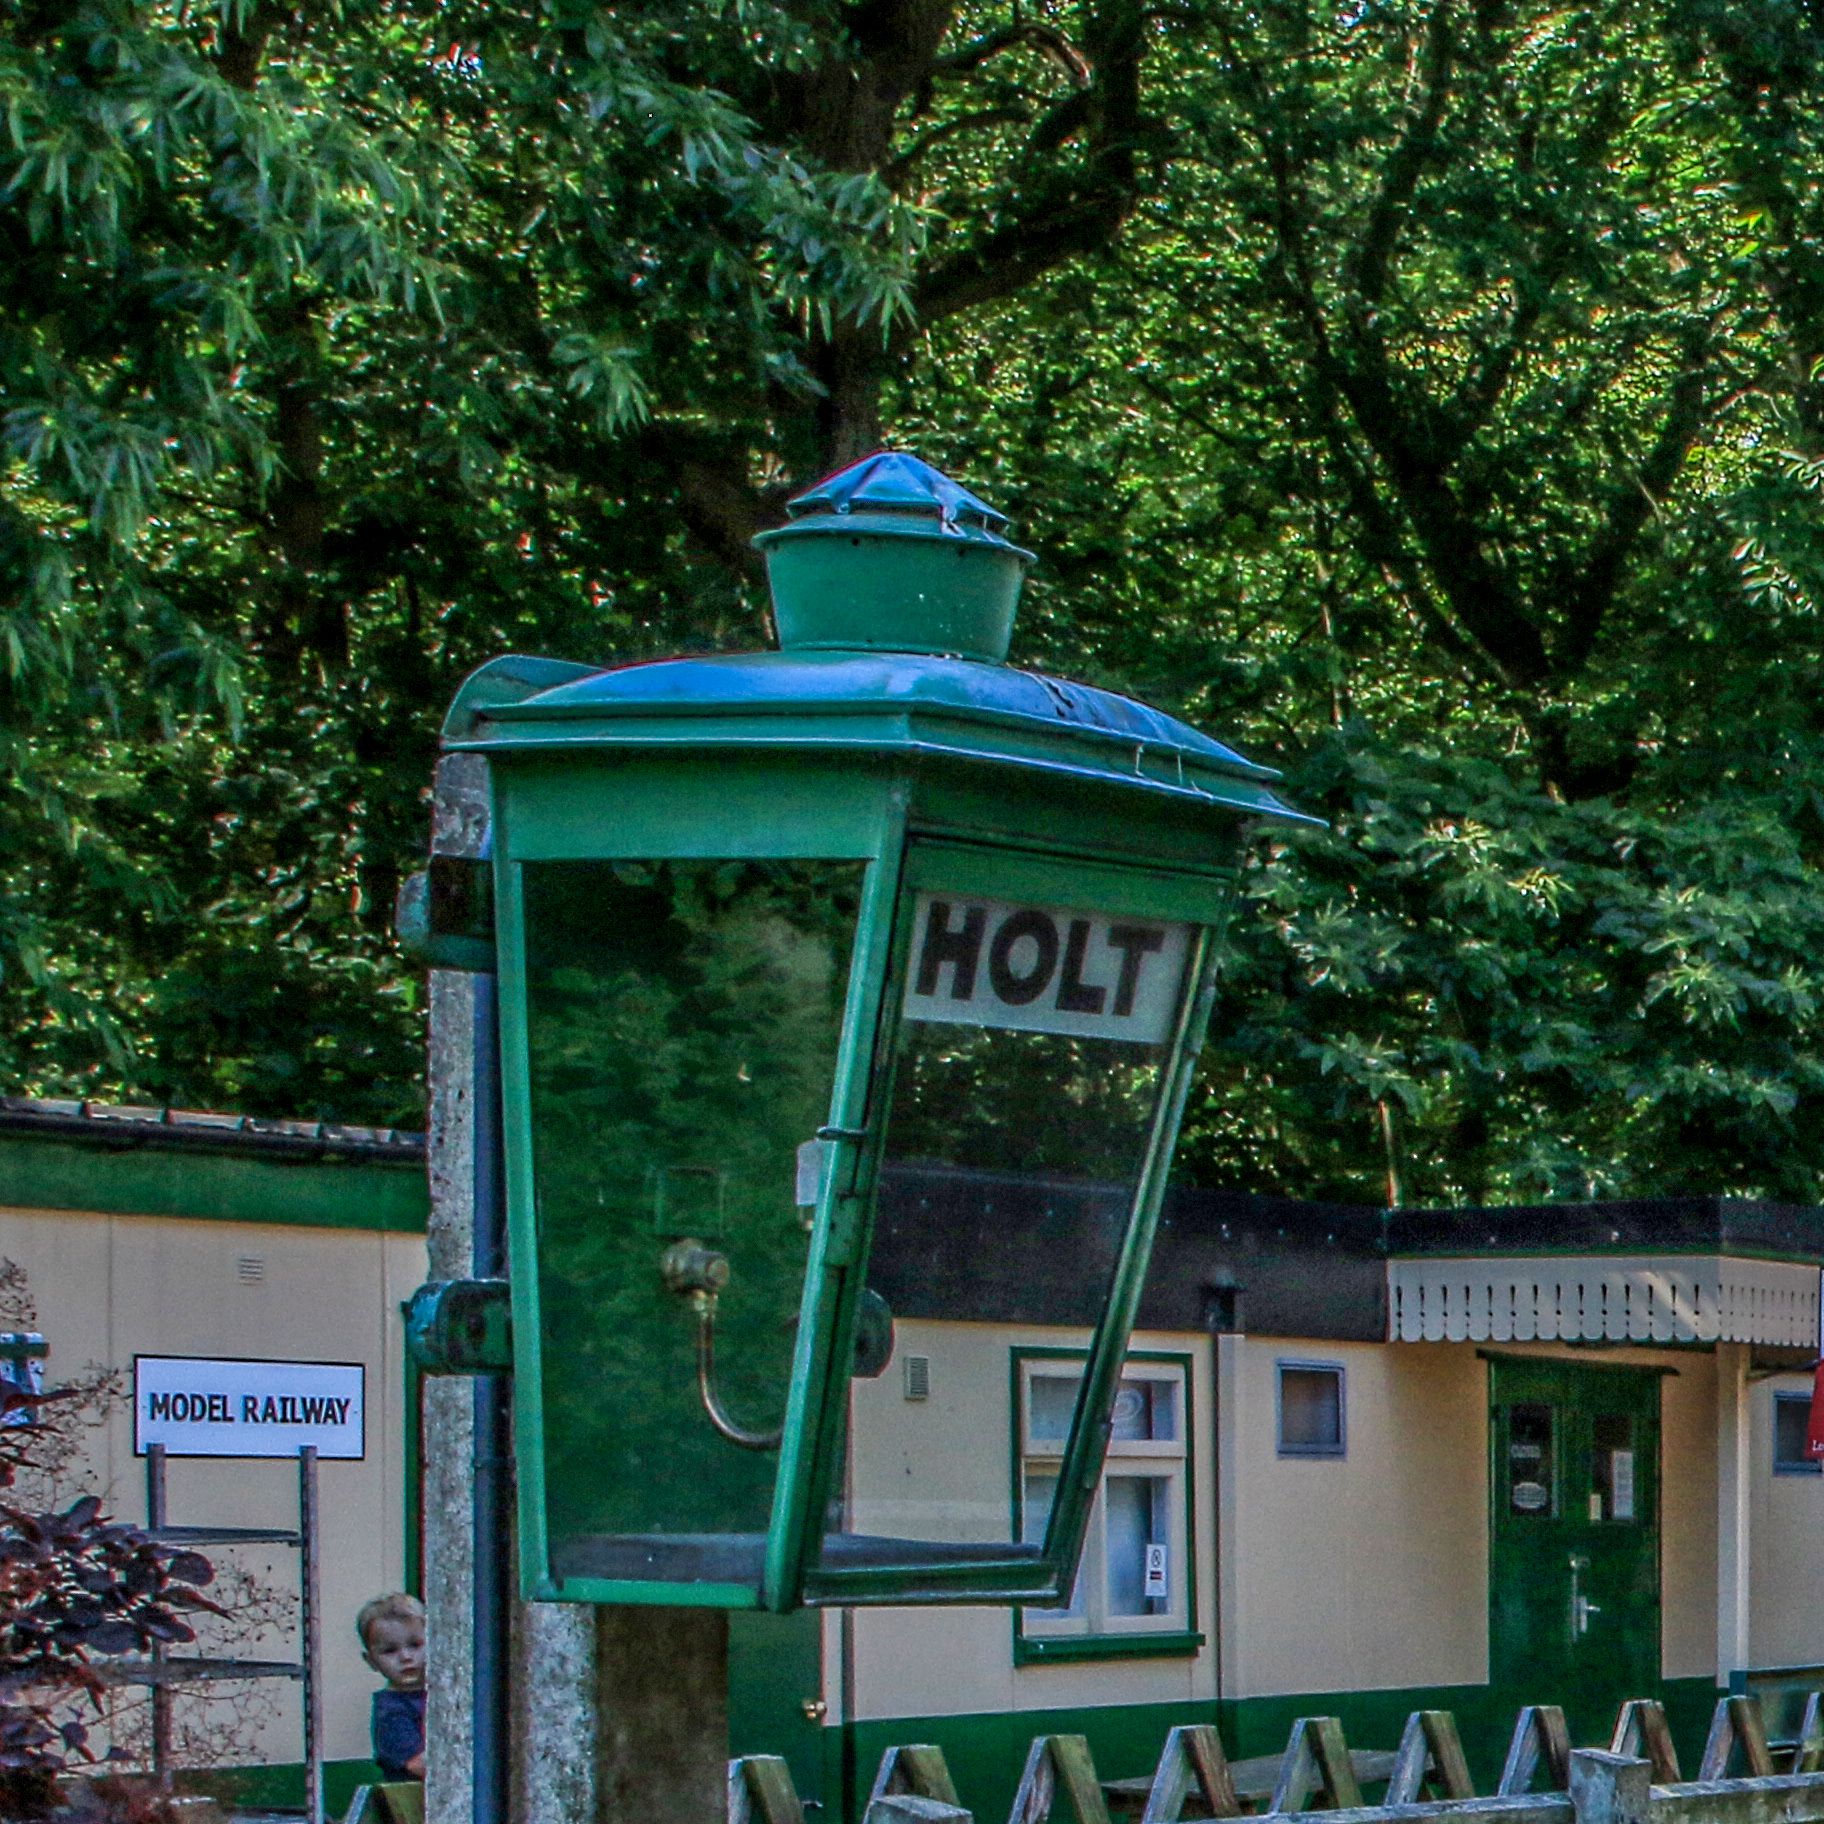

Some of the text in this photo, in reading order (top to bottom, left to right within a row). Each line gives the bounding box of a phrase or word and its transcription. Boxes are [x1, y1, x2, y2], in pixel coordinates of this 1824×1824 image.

[915, 901, 1166, 1017] HOLT
[149, 1392, 350, 1425] MODEL RAILWAY
